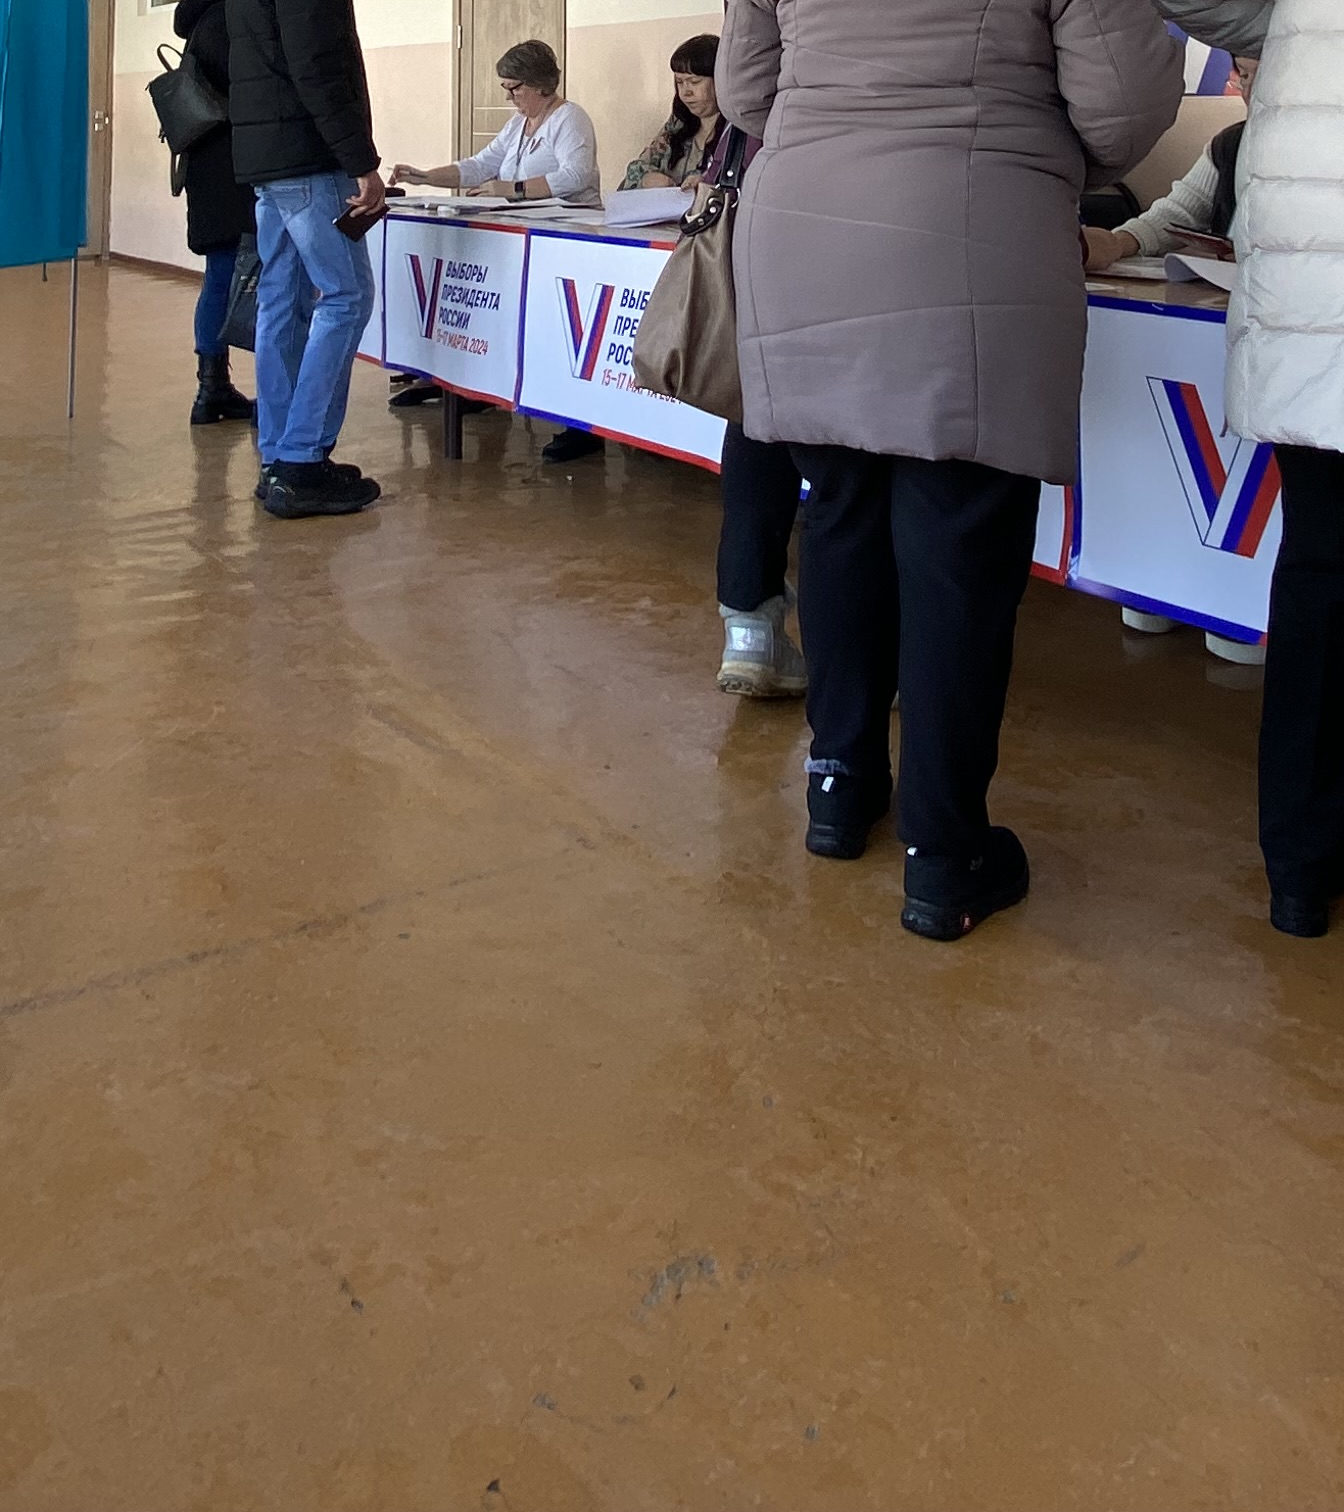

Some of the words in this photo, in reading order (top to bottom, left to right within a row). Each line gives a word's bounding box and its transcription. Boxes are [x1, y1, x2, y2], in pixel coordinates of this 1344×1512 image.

[445, 261, 488, 284] ВЫБОРЫ
[441, 284, 501, 311] ПРЕЗИДЕНТА
[438, 306, 471, 330] РОССИИ
[469, 338, 489, 356] 2024
